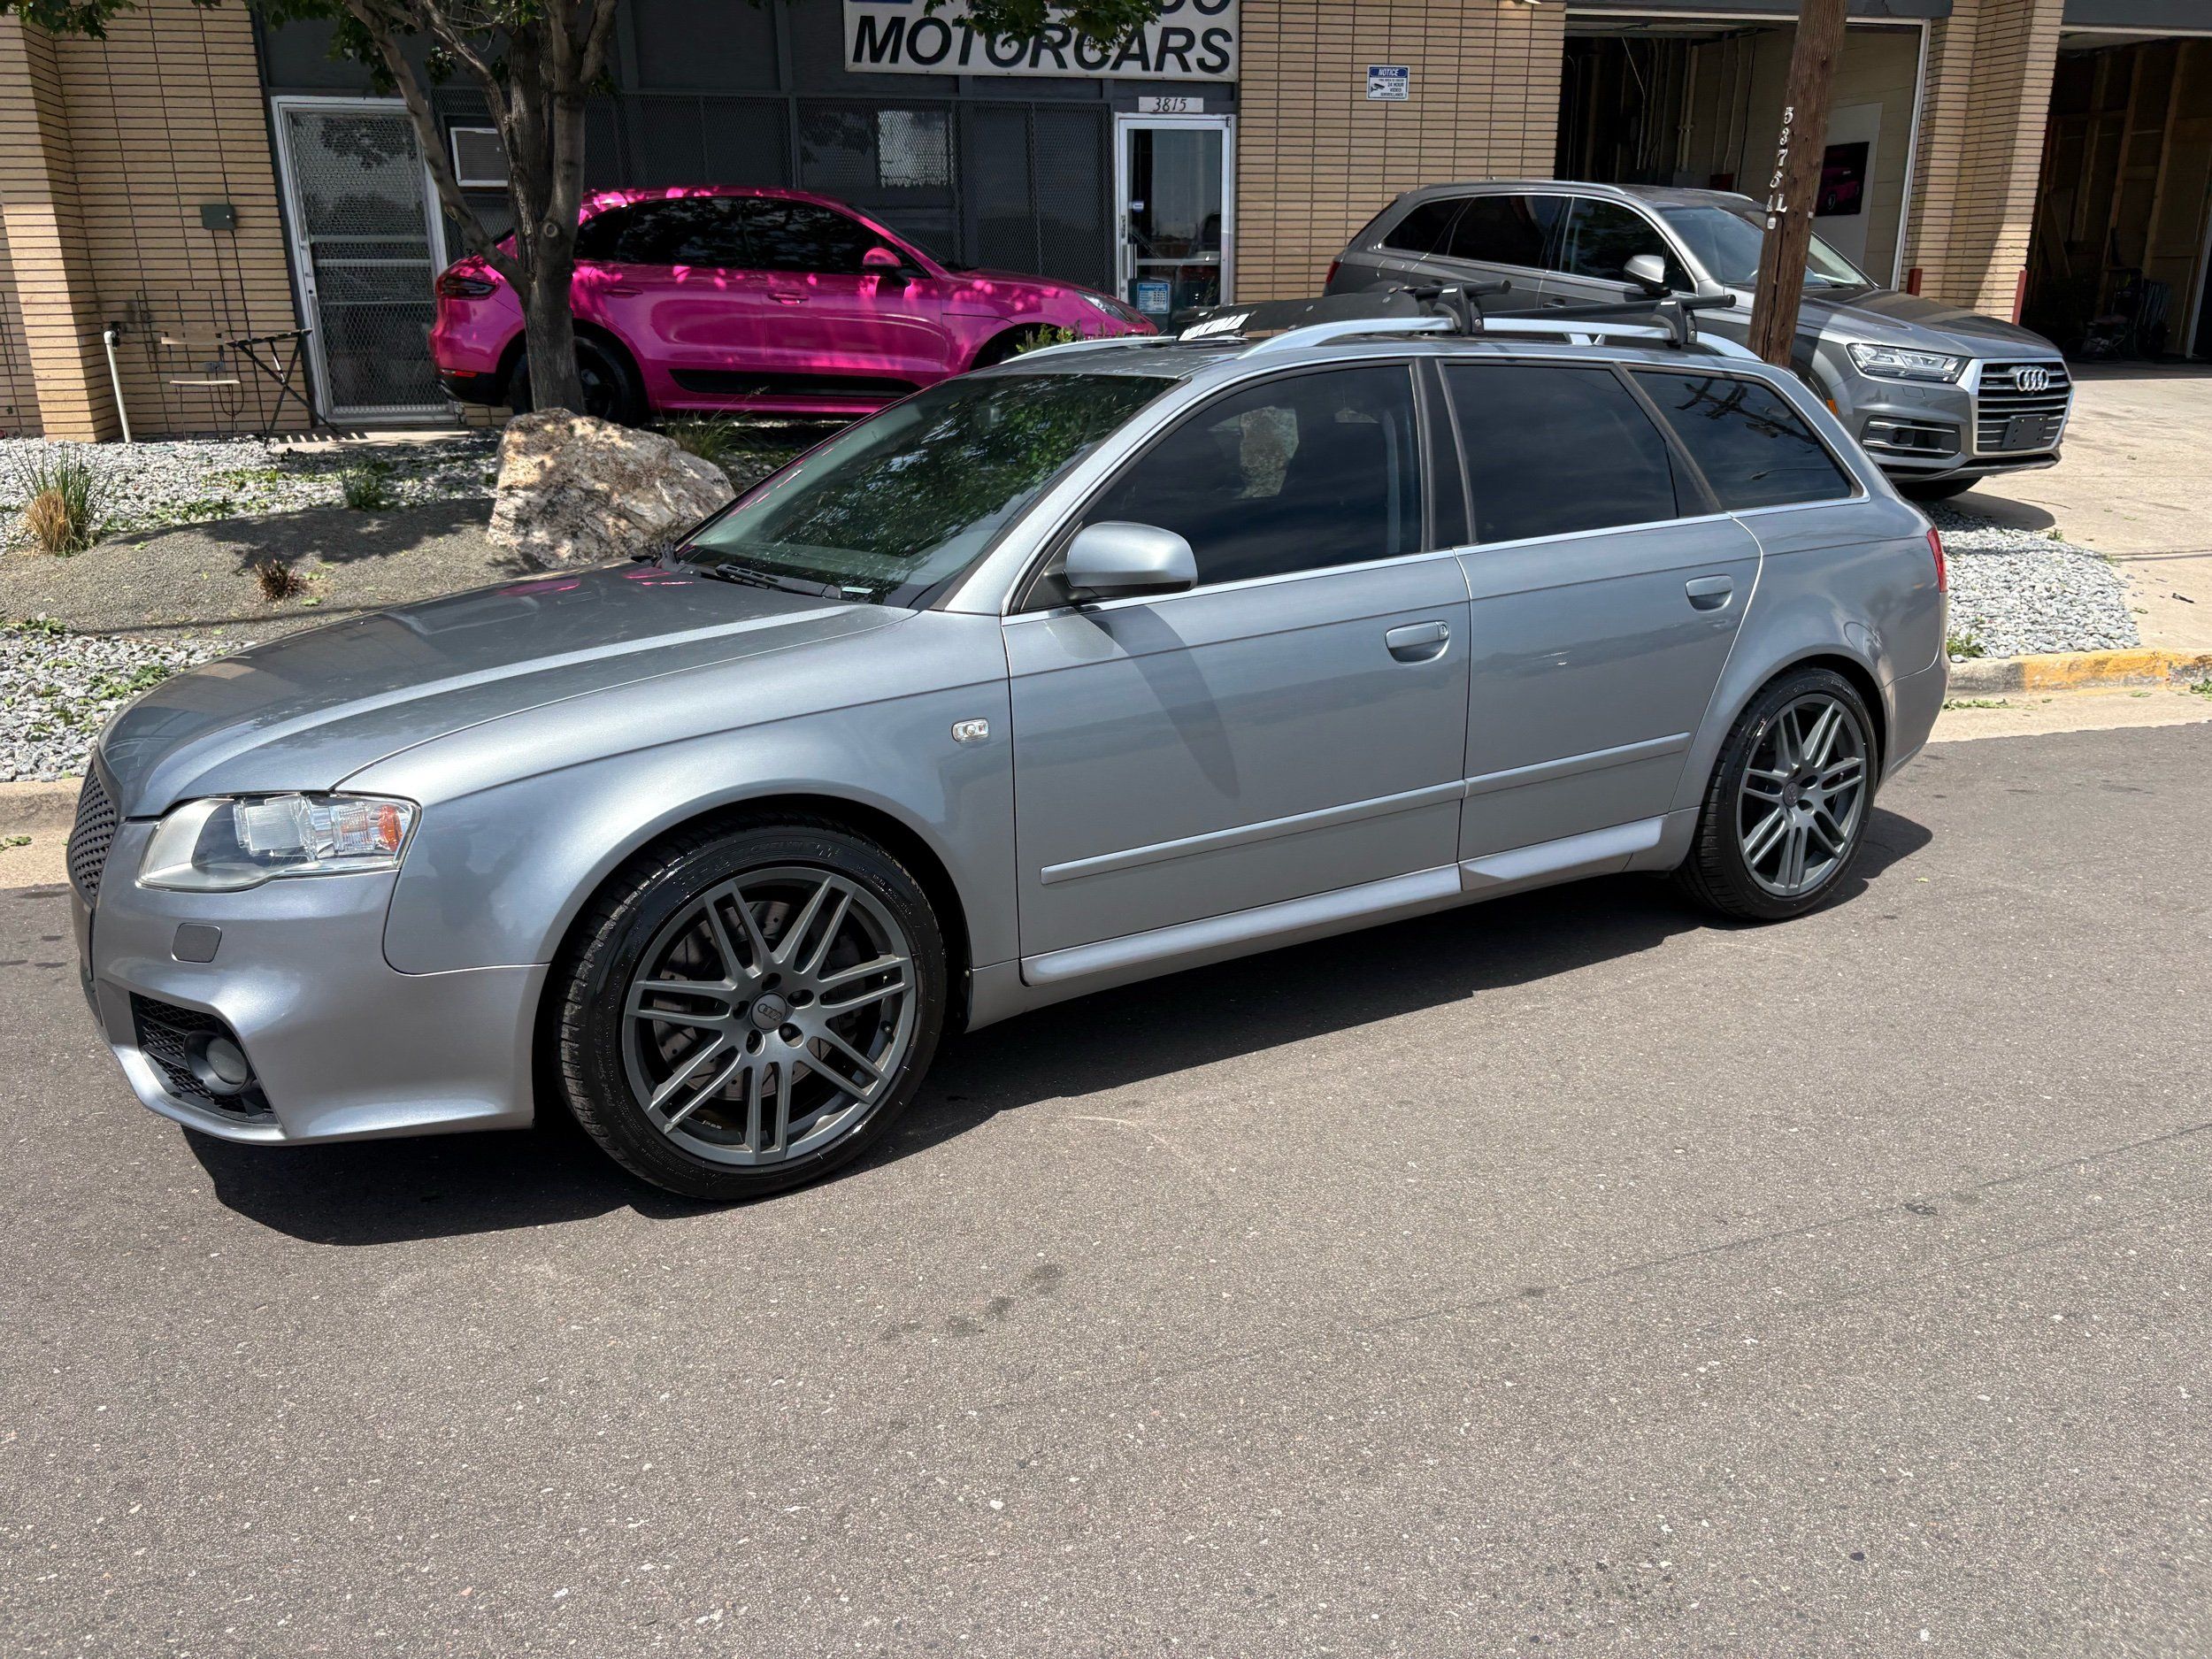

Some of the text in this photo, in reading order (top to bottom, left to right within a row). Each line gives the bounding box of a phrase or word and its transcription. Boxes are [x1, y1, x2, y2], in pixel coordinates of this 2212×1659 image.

[852, 15, 1233, 74] MOTORCARS
[1379, 68, 1399, 77] NOTICE
[1153, 97, 1187, 112] 3815
